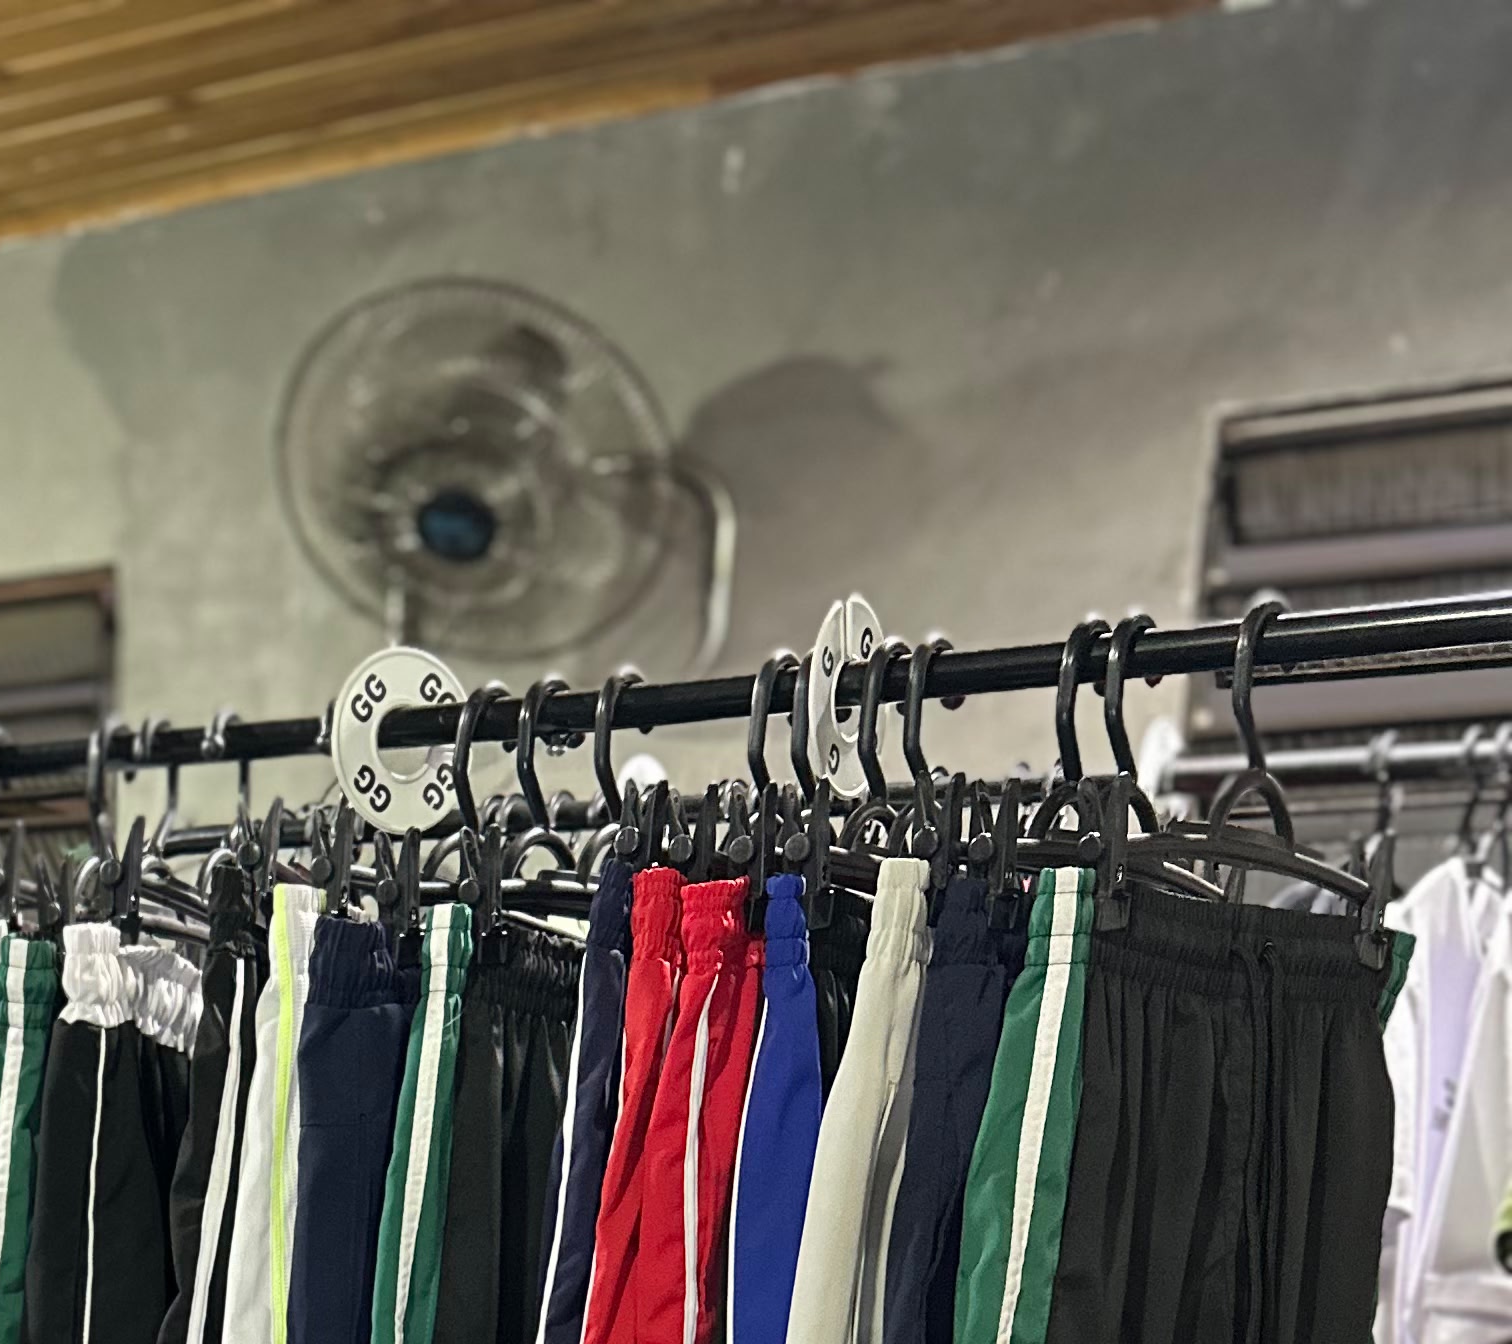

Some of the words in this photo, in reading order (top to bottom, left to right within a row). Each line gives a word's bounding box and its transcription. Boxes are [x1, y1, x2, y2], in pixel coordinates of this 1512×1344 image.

[822, 646, 834, 677] G
[860, 627, 873, 659] G
[351, 673, 387, 722] GG
[353, 764, 392, 813] GG
